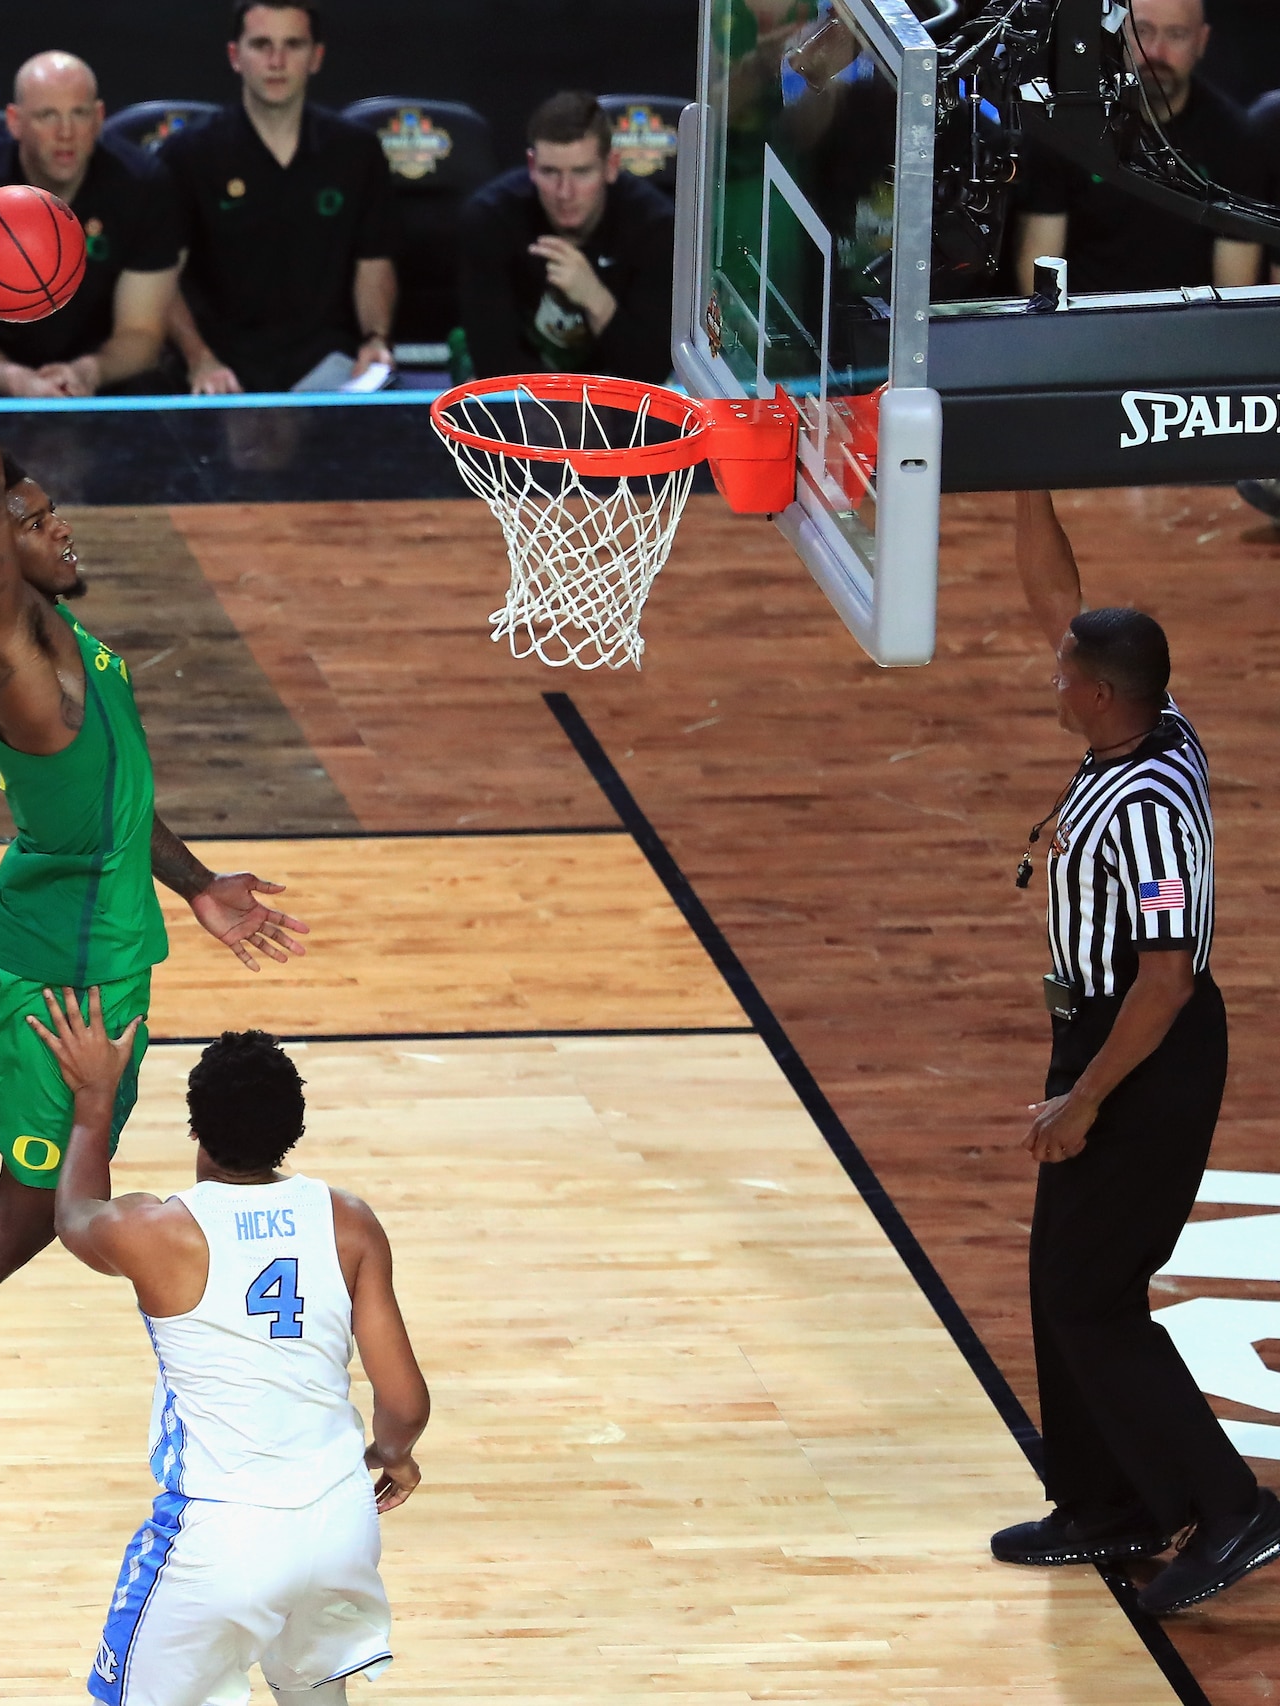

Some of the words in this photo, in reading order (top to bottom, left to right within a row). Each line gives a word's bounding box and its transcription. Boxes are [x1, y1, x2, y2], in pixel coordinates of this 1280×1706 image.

[1120, 390, 1280, 449] SPALD
[234, 1208, 296, 1240] HICKS
[245, 1257, 304, 1339] 4
